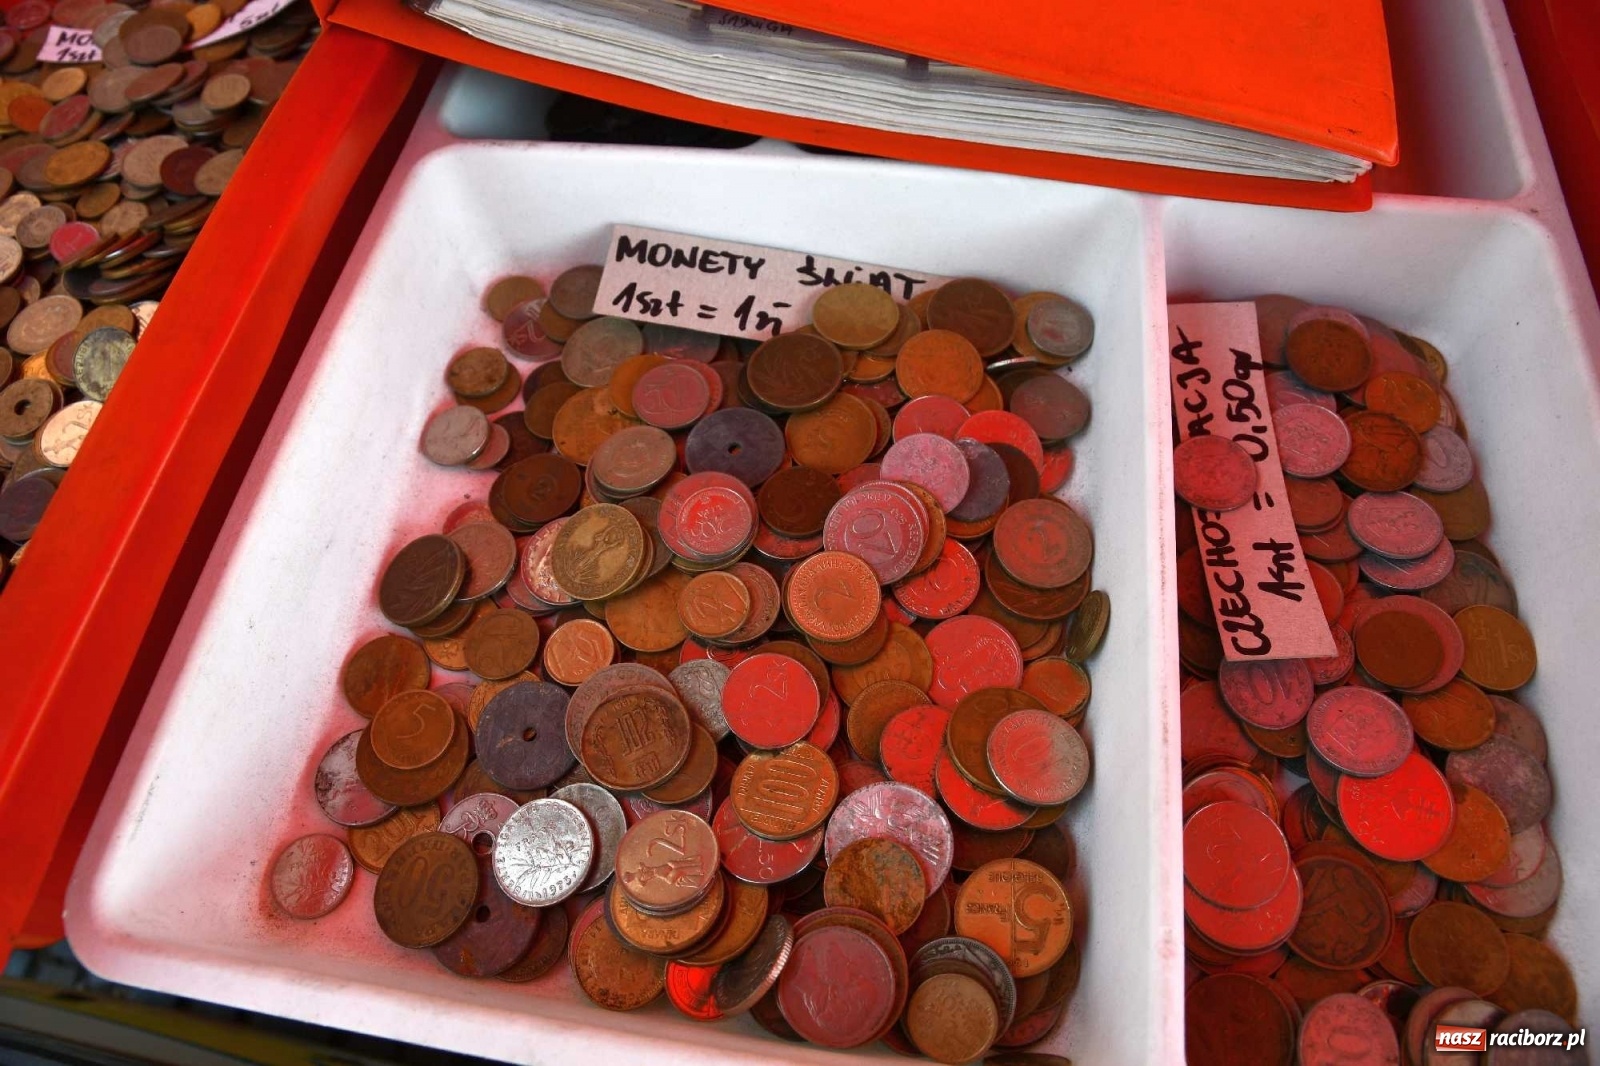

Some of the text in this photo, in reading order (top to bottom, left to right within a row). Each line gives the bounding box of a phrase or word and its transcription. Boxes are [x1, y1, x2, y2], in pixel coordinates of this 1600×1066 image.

[614, 234, 766, 279] MONETY
[395, 702, 437, 739] 5
[1014, 883, 1058, 956] 5
